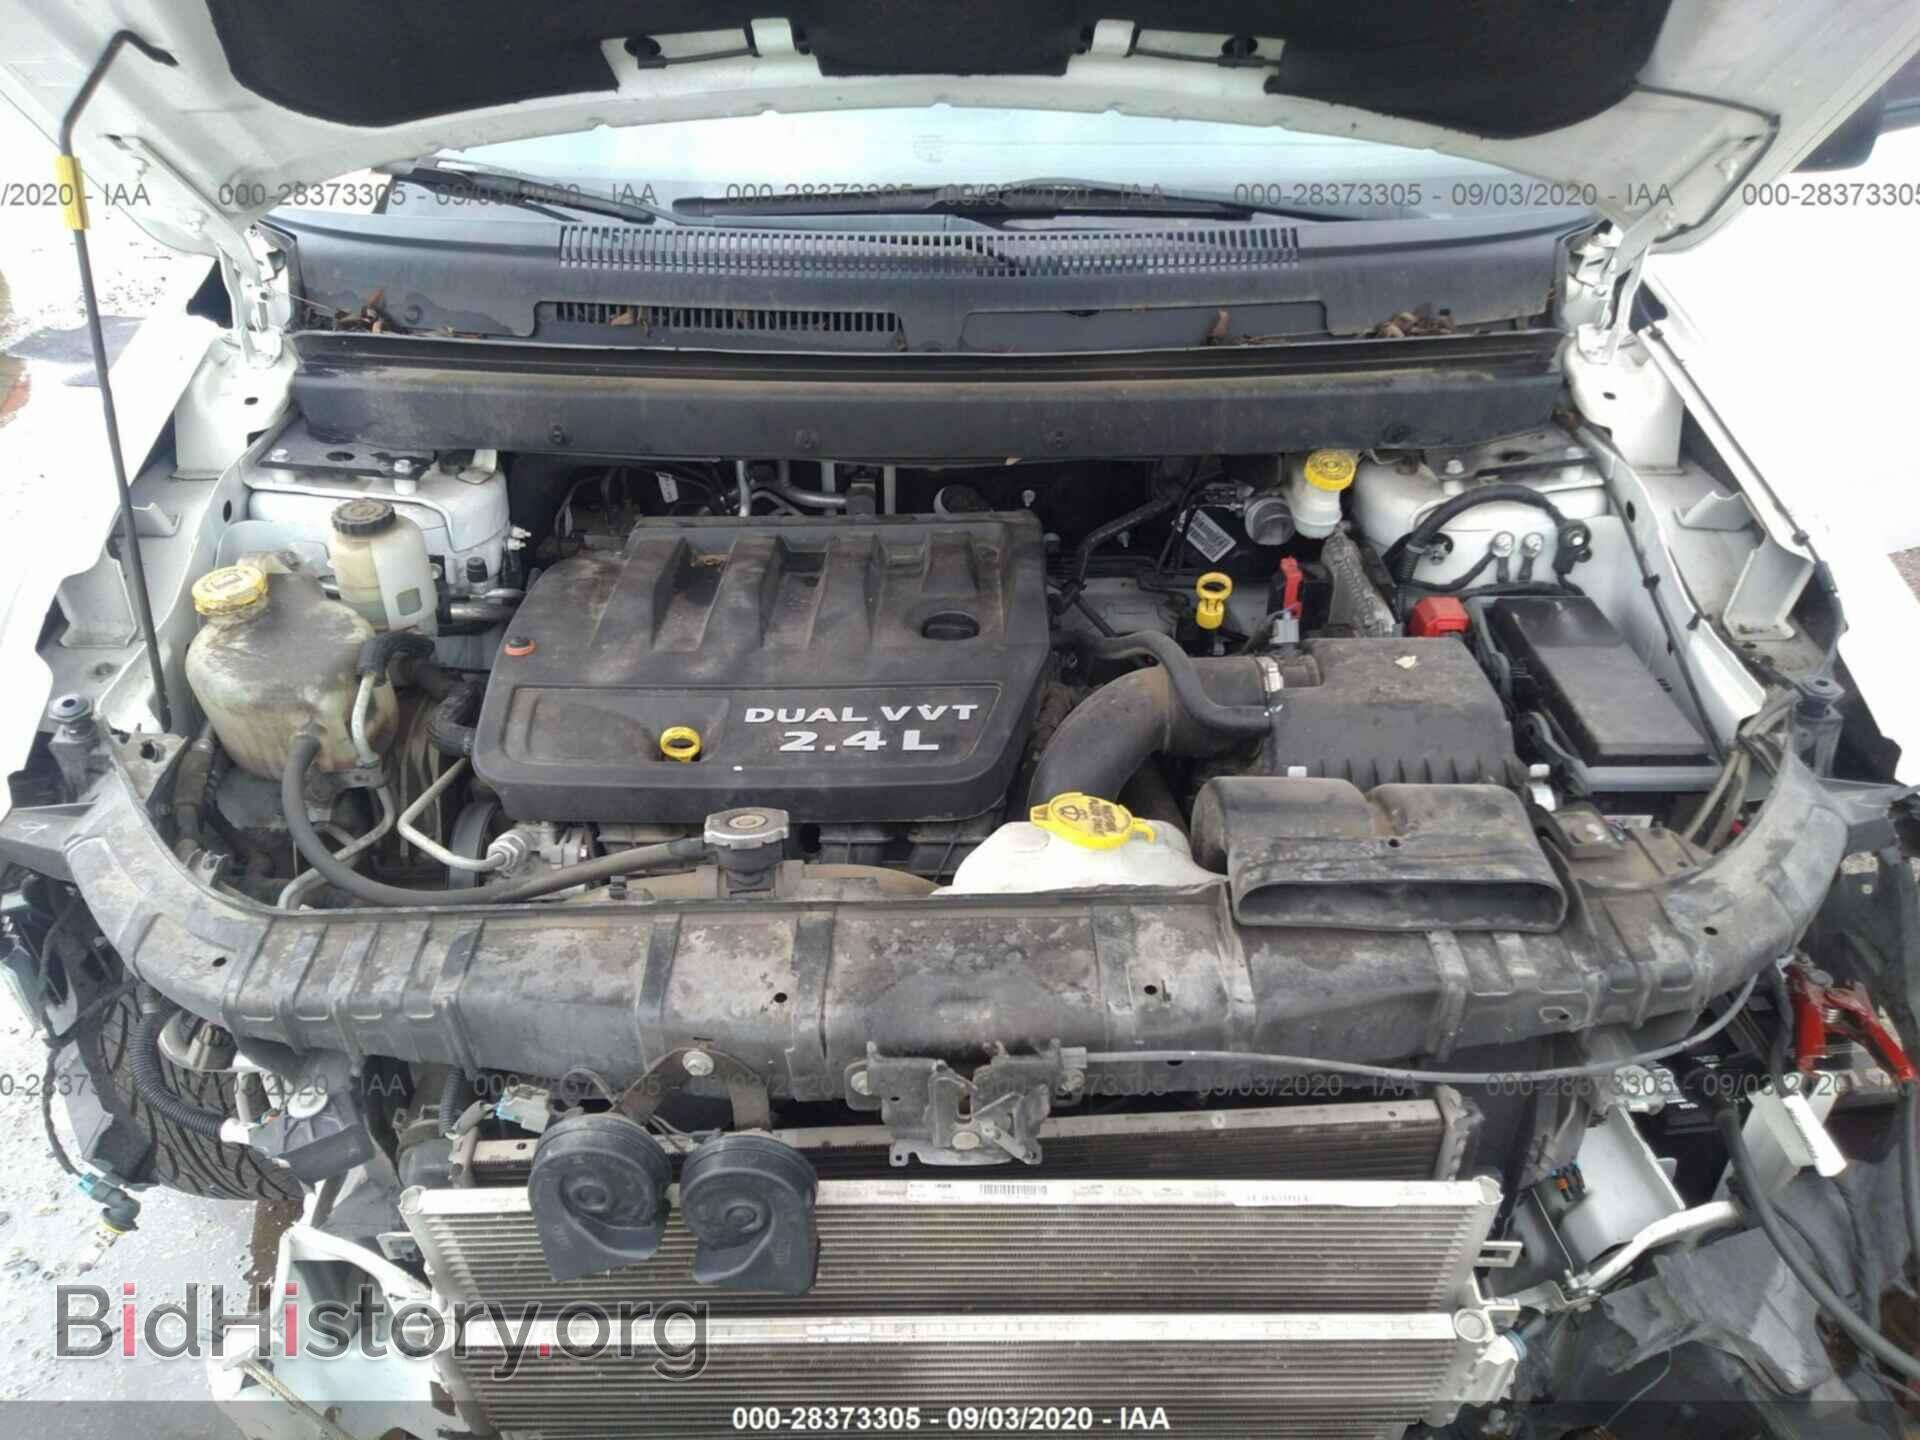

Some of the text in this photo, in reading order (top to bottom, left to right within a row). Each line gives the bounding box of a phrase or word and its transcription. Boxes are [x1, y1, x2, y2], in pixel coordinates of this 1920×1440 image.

[744, 704, 979, 723] DUAL VVT
[779, 729, 940, 751] 2.4 L
